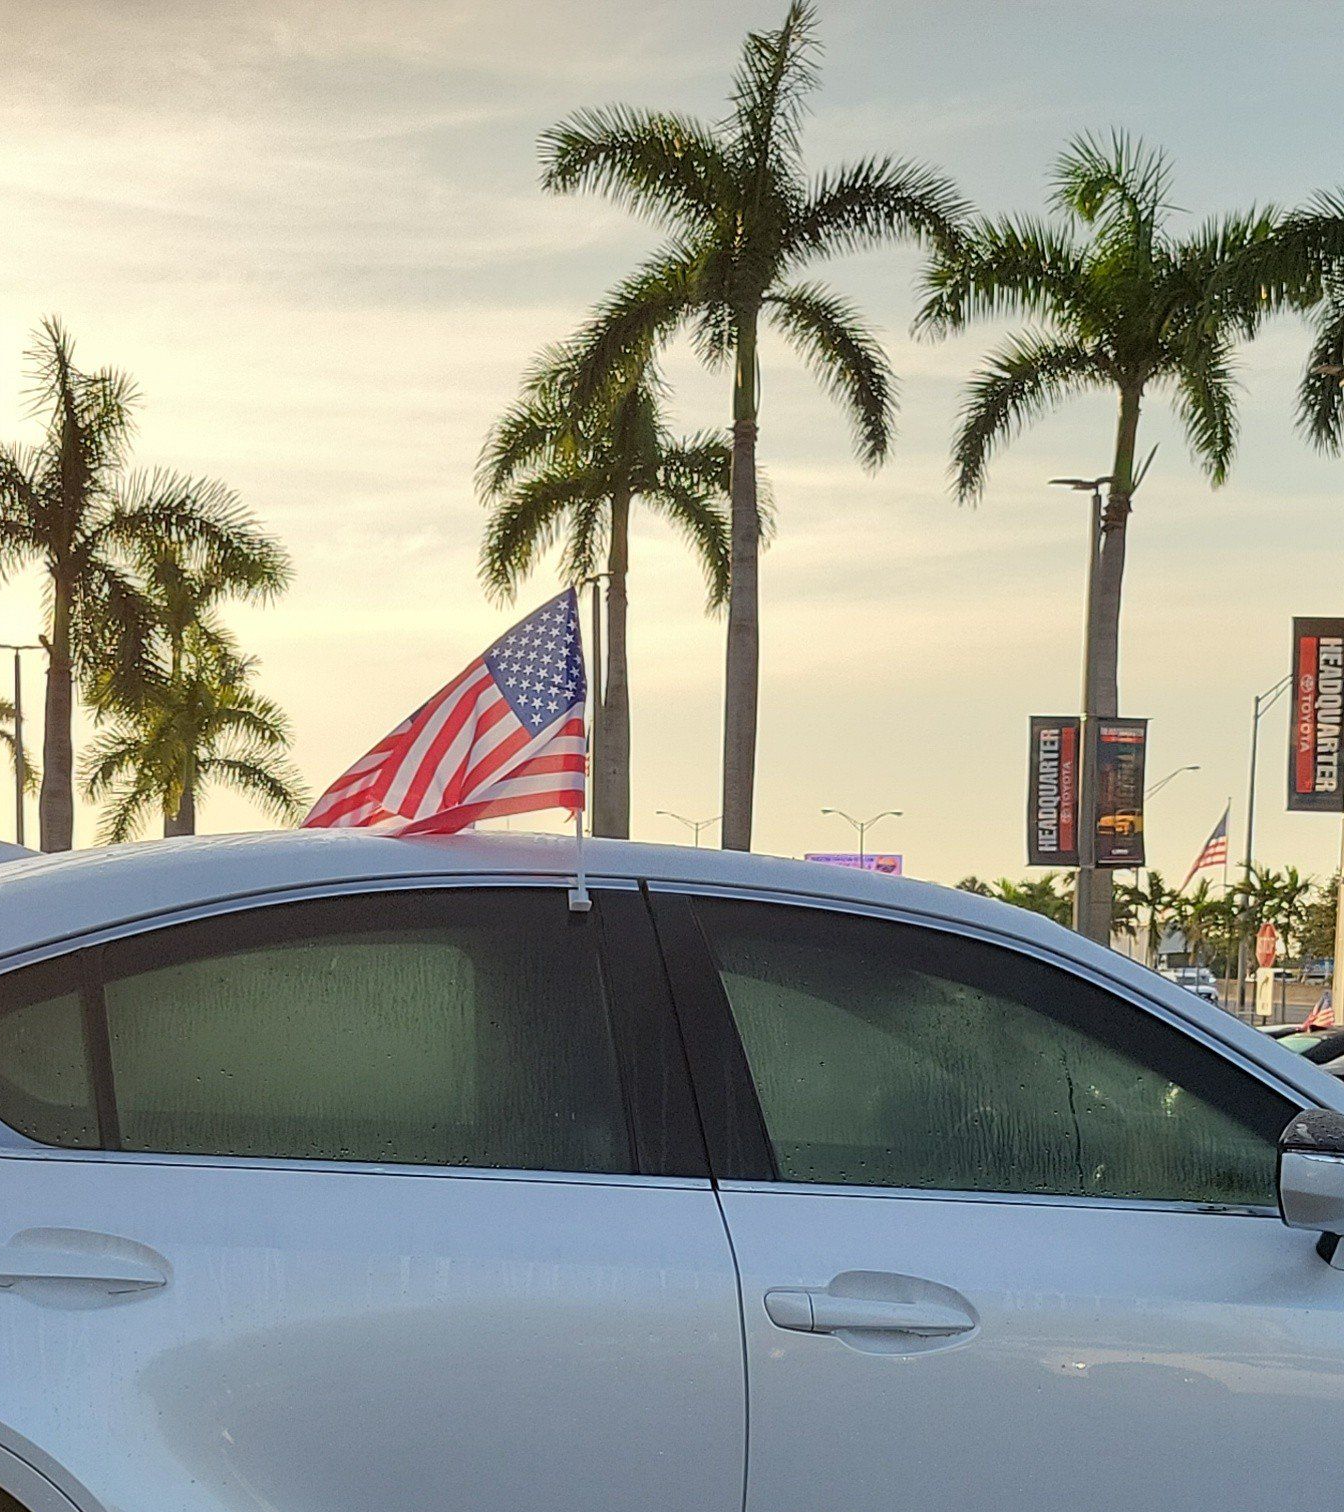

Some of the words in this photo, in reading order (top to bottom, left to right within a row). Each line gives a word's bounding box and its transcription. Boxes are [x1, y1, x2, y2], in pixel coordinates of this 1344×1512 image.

[1299, 695, 1313, 753] TOYOTA
[1314, 636, 1343, 793] HEADQUARTER
[1037, 729, 1060, 852] HEADQUARTER
[1061, 761, 1074, 810] TOYOTA
